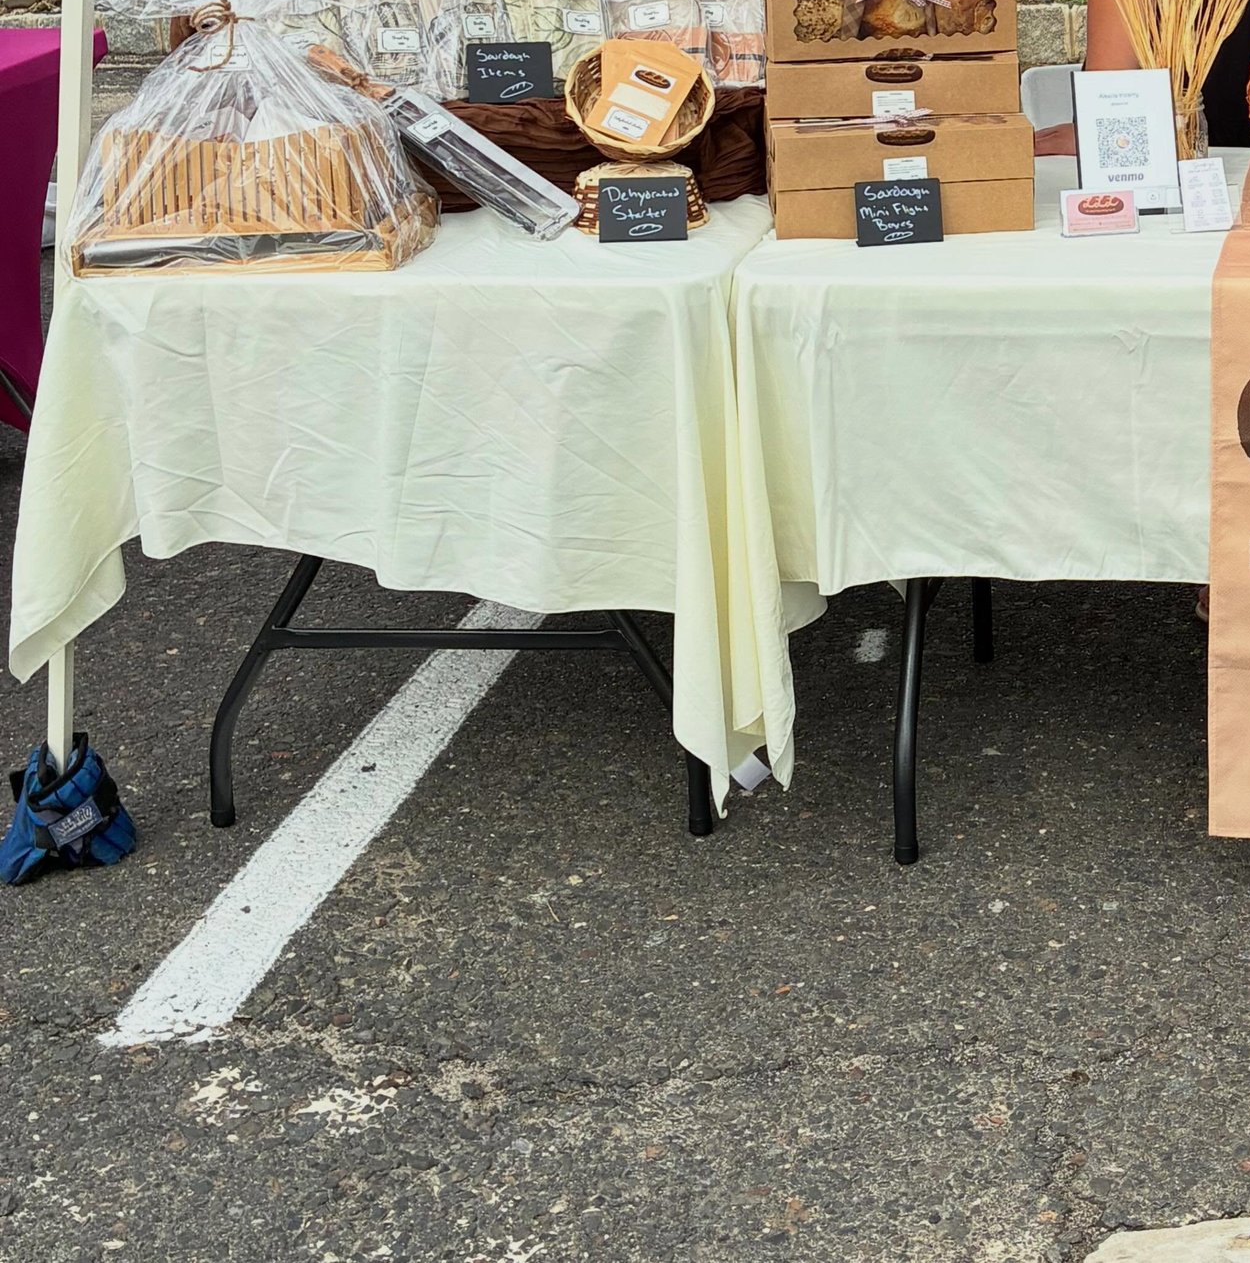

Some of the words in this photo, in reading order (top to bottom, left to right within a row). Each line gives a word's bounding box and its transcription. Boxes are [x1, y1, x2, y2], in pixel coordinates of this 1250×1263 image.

[476, 49, 531, 62] Sourdough
[477, 67, 526, 79] Items
[1108, 173, 1144, 183] venmo
[601, 186, 680, 206] Dehydrated
[864, 186, 930, 200] Sourdough
[612, 204, 667, 220] Starter
[859, 205, 889, 219] Mini
[872, 218, 914, 231] Boxes
